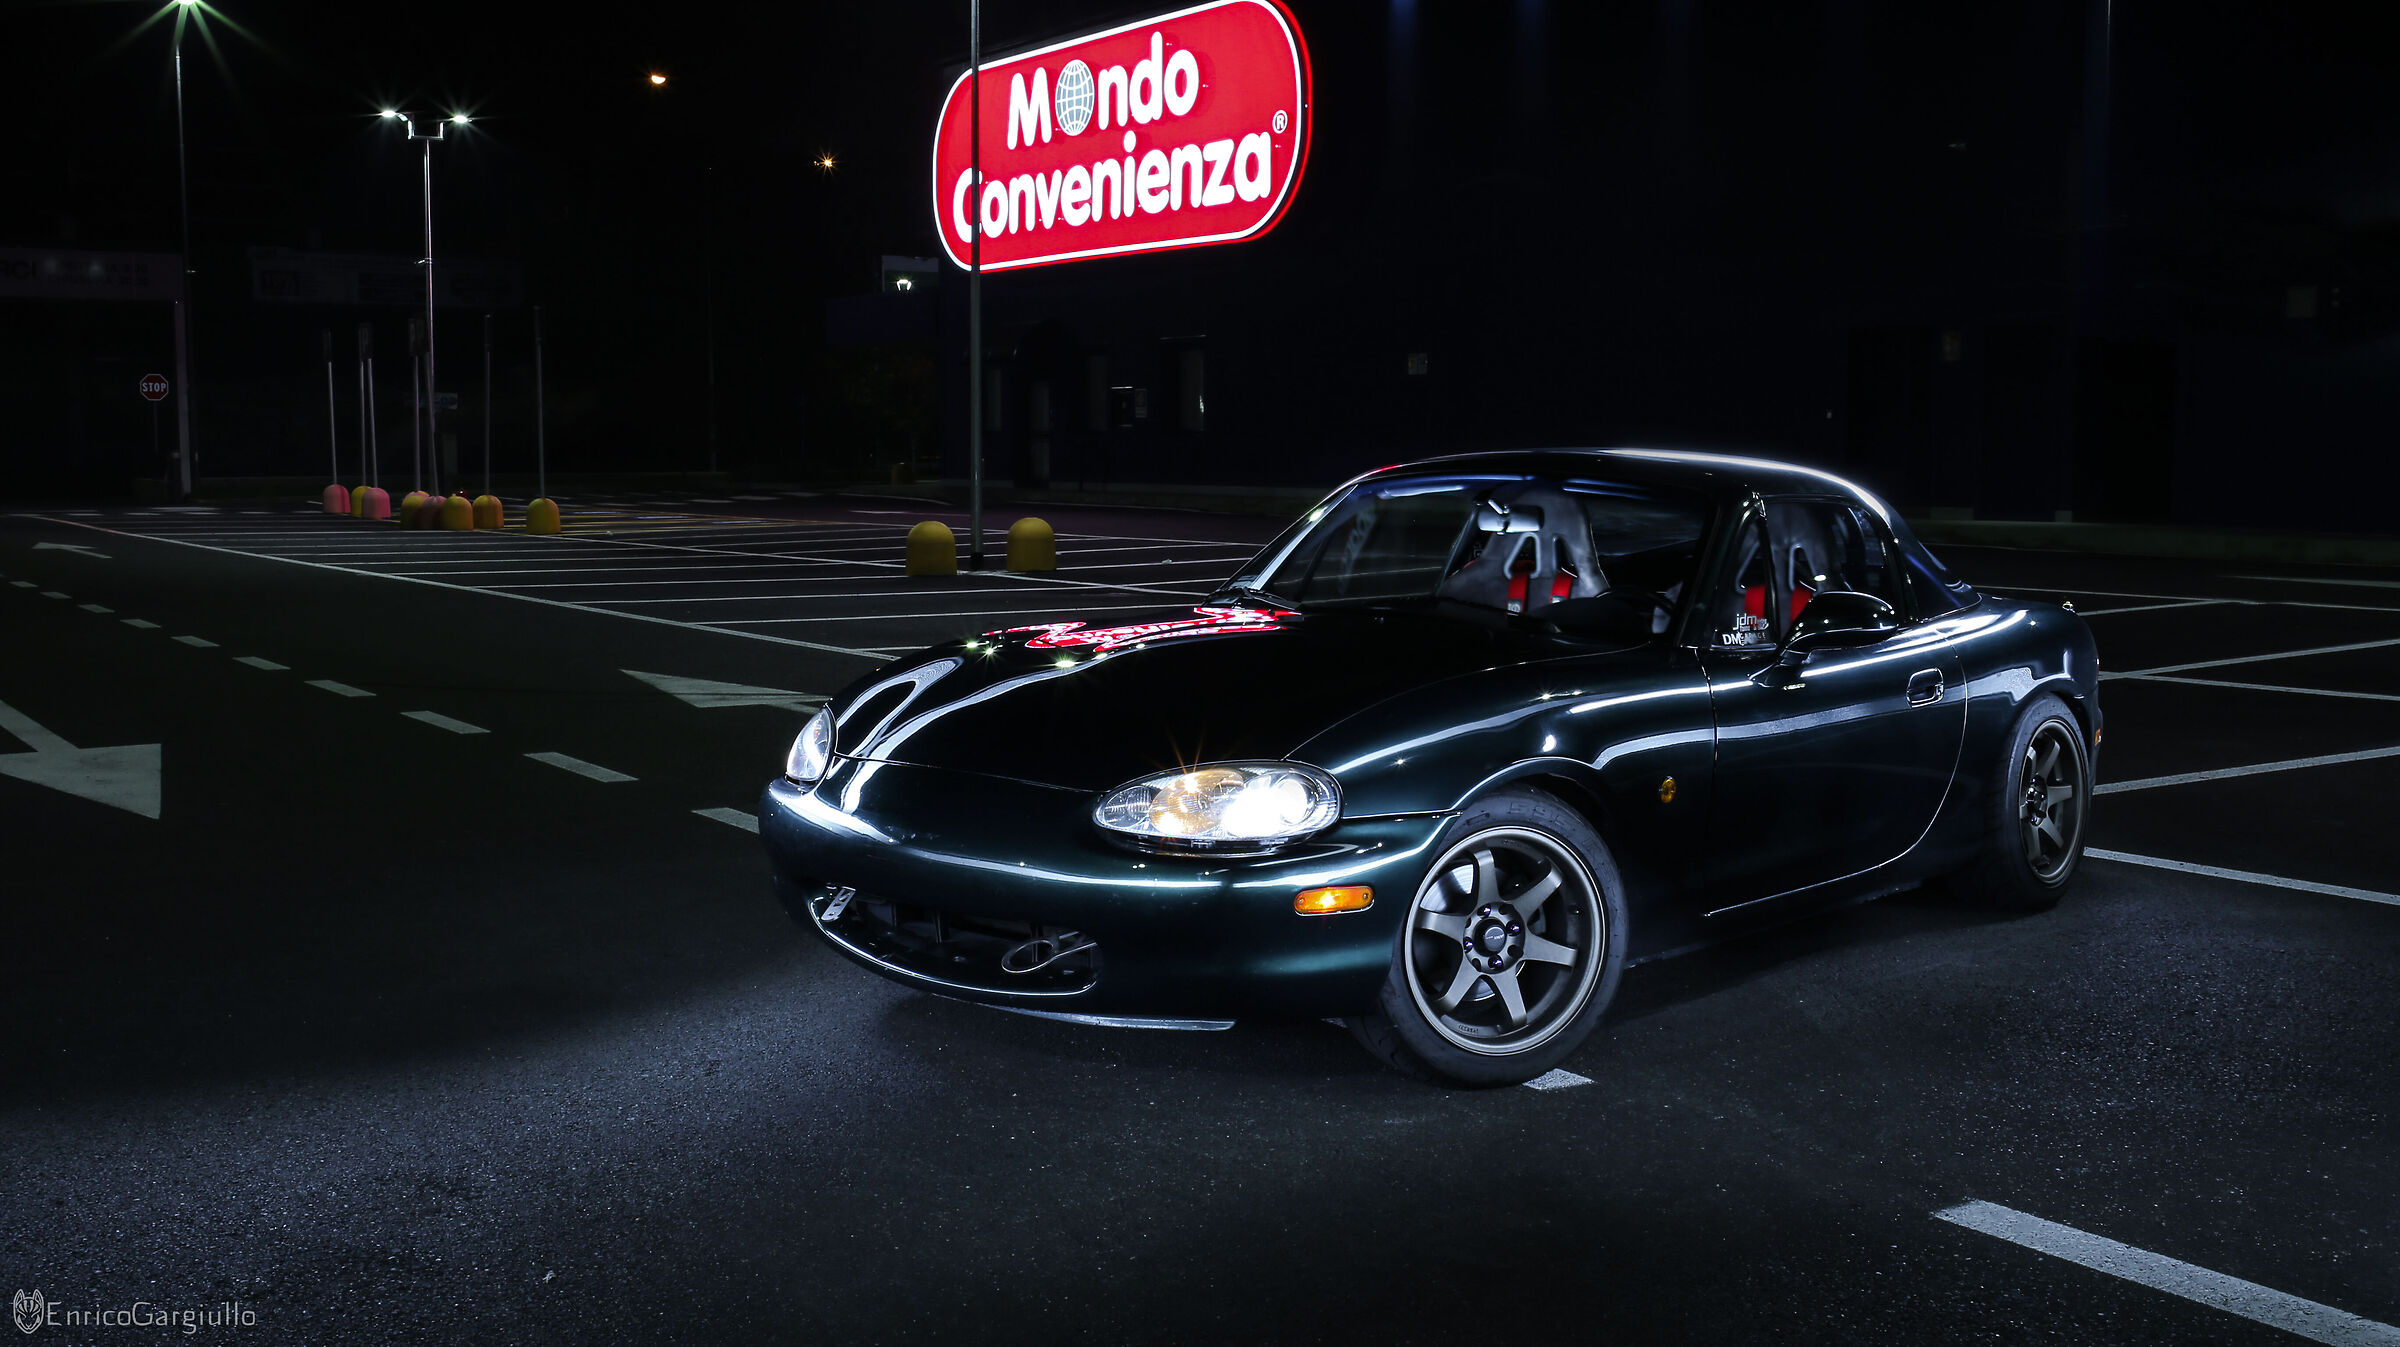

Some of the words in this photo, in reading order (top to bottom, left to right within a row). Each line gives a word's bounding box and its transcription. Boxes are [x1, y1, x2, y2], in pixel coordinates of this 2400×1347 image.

[1007, 31, 1199, 150] Mondo
[953, 130, 1271, 243] Convenienza
[142, 382, 167, 392] STOP
